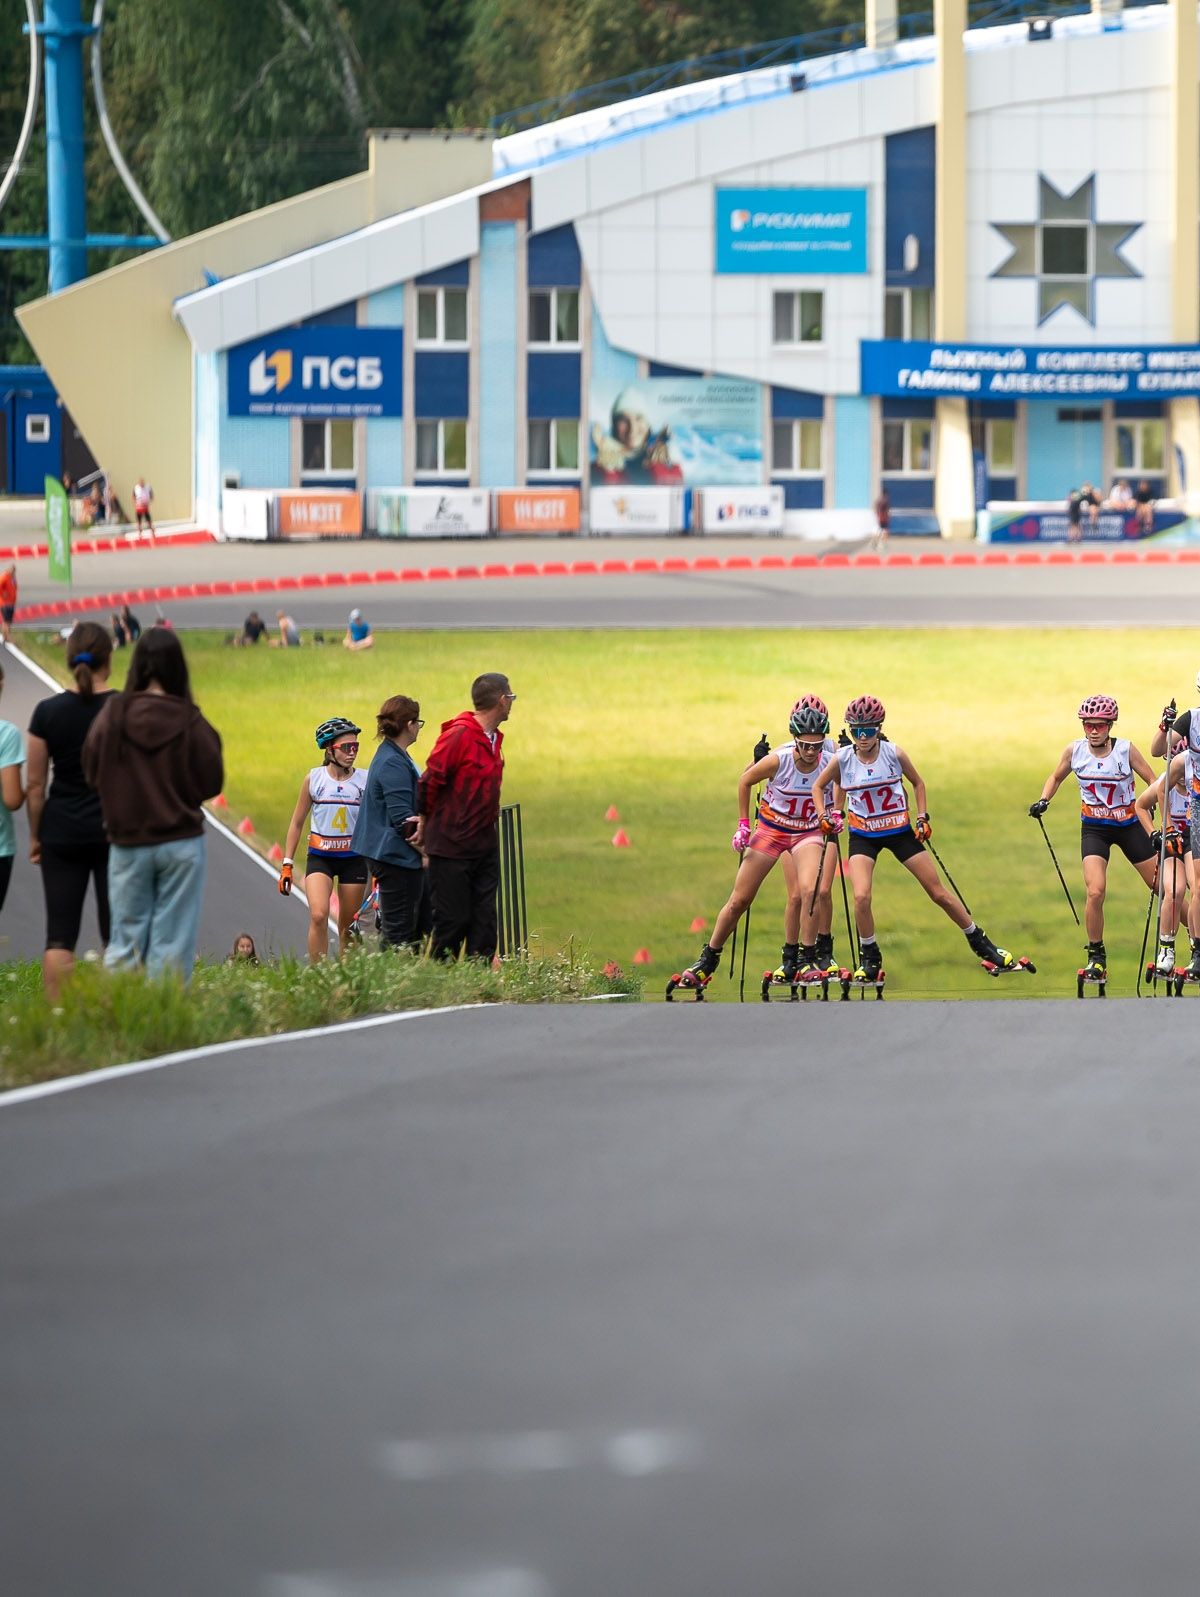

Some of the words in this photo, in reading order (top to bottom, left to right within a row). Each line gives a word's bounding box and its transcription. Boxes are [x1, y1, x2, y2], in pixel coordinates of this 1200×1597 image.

[302, 355, 384, 391] ПСБ
[930, 349, 1027, 371] ЛЫЖНЫЙ
[1036, 352, 1145, 372] КОМПЛЕКС
[898, 368, 982, 391] ГАЛИНЫ
[989, 372, 1130, 394] АЛЕКСЕЕВНЫ
[860, 785, 899, 814] 12
[1085, 782, 1117, 806] 17
[331, 806, 349, 834] 4
[785, 797, 816, 821] 16
[319, 838, 351, 851] УДМУРТ
